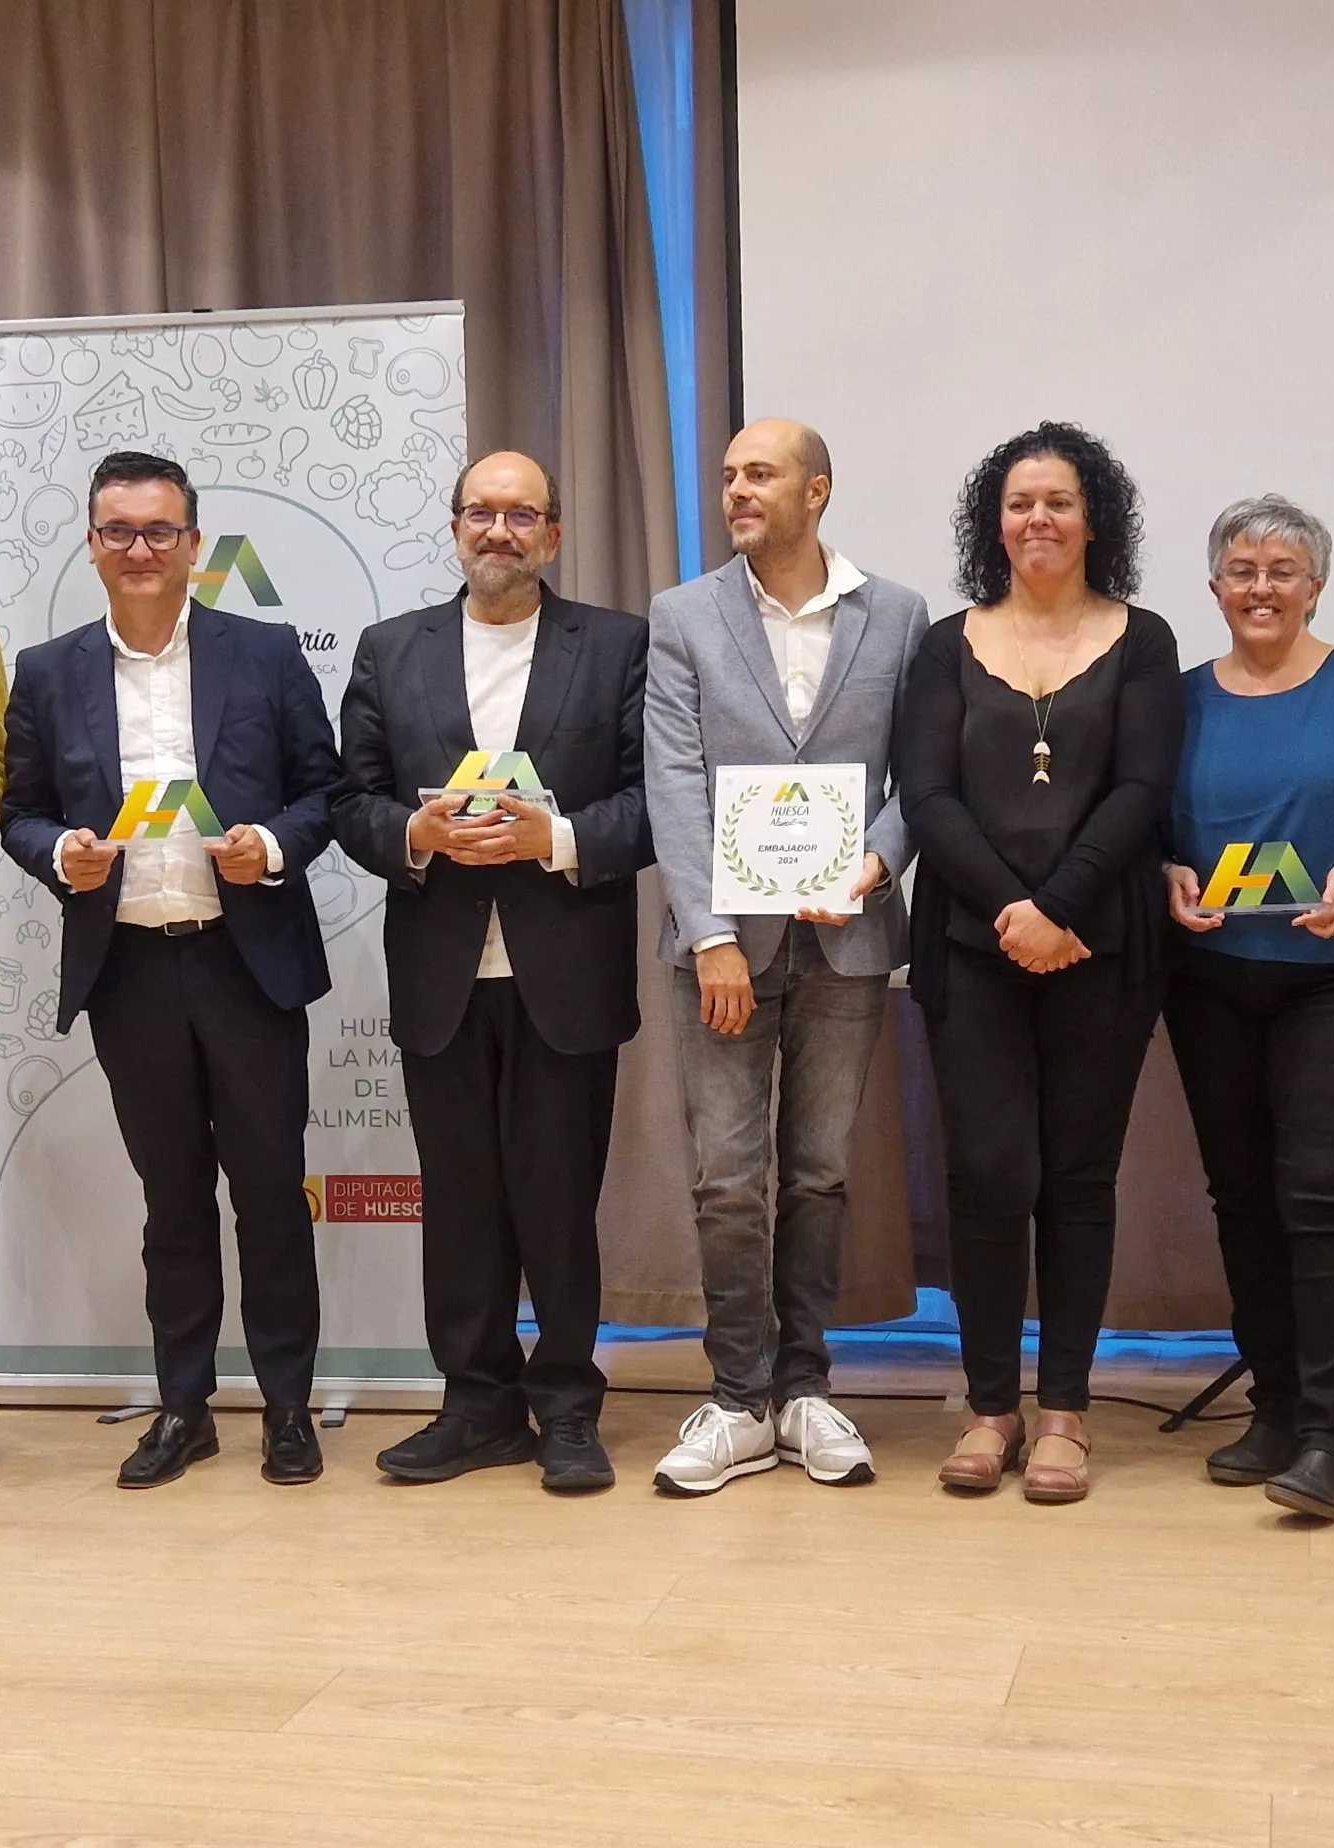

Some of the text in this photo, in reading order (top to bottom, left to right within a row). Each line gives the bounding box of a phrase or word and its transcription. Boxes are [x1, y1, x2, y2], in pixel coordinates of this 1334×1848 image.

[771, 806, 809, 816] HUESCA
[758, 844, 818, 852] EMBAJADOR
[777, 856, 798, 864] 2024
[329, 1048, 360, 1067] LA
[354, 1079, 389, 1097] DE
[334, 1202, 358, 1216] DE
